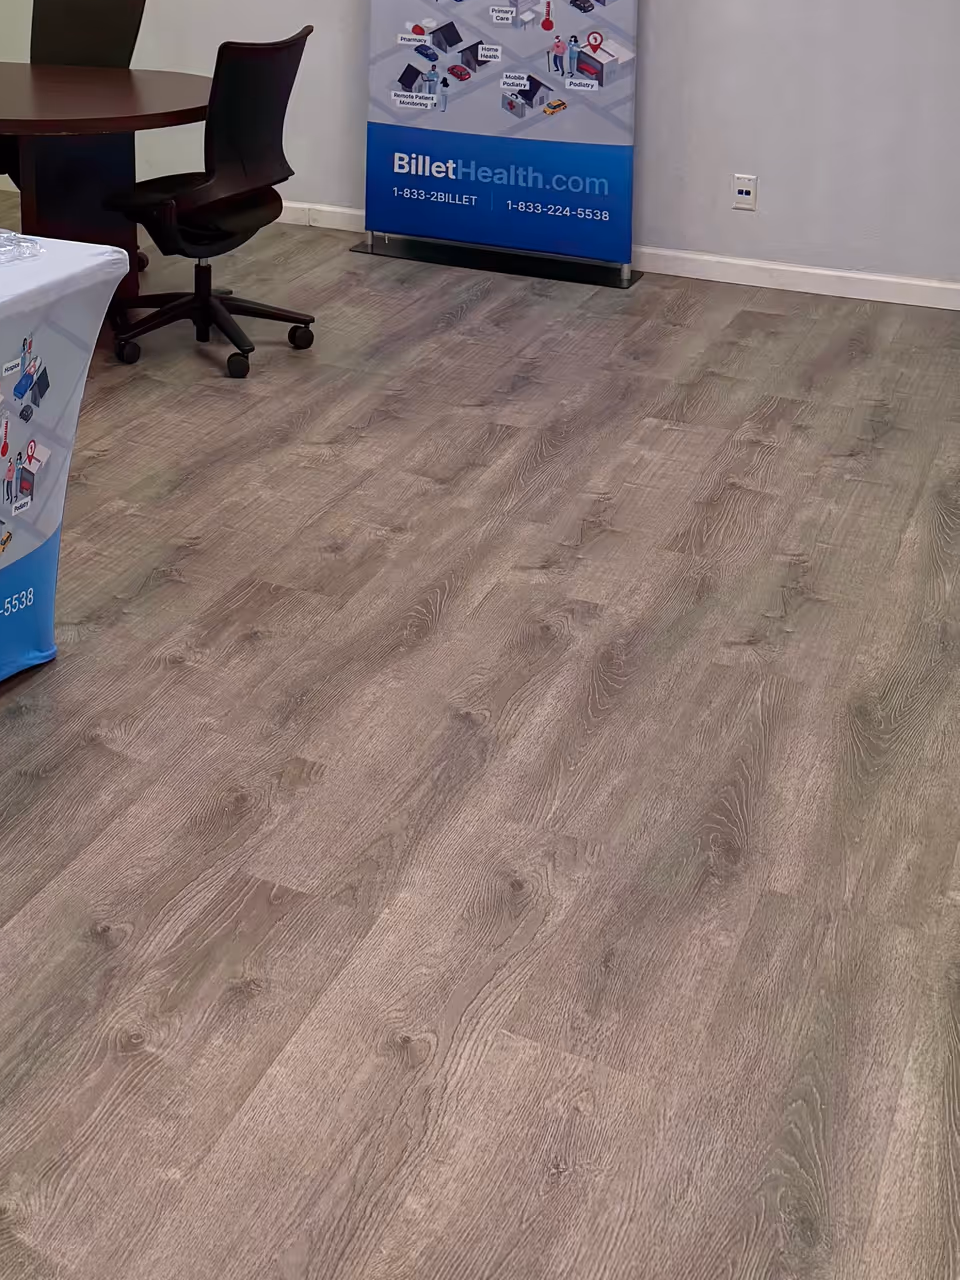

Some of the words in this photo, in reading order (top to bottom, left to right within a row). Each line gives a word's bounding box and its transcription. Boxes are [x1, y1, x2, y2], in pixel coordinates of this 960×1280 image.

[491, 8, 515, 17] Primary
[400, 36, 427, 45] Pharmacy
[480, 53, 500, 61] Health
[504, 73, 525, 81] Mobile
[503, 80, 527, 90] Podiatry
[569, 81, 595, 90] Podiatry
[393, 93, 414, 101] Remote
[399, 100, 429, 109] Monitoring
[393, 152, 609, 196] BilletHealth.com
[393, 187, 477, 206] 1-833-2BILLET
[507, 200, 610, 221] 1-833-224-5538
[4, 362, 20, 374] Hospice
[14, 501, 29, 513] Podiatry
